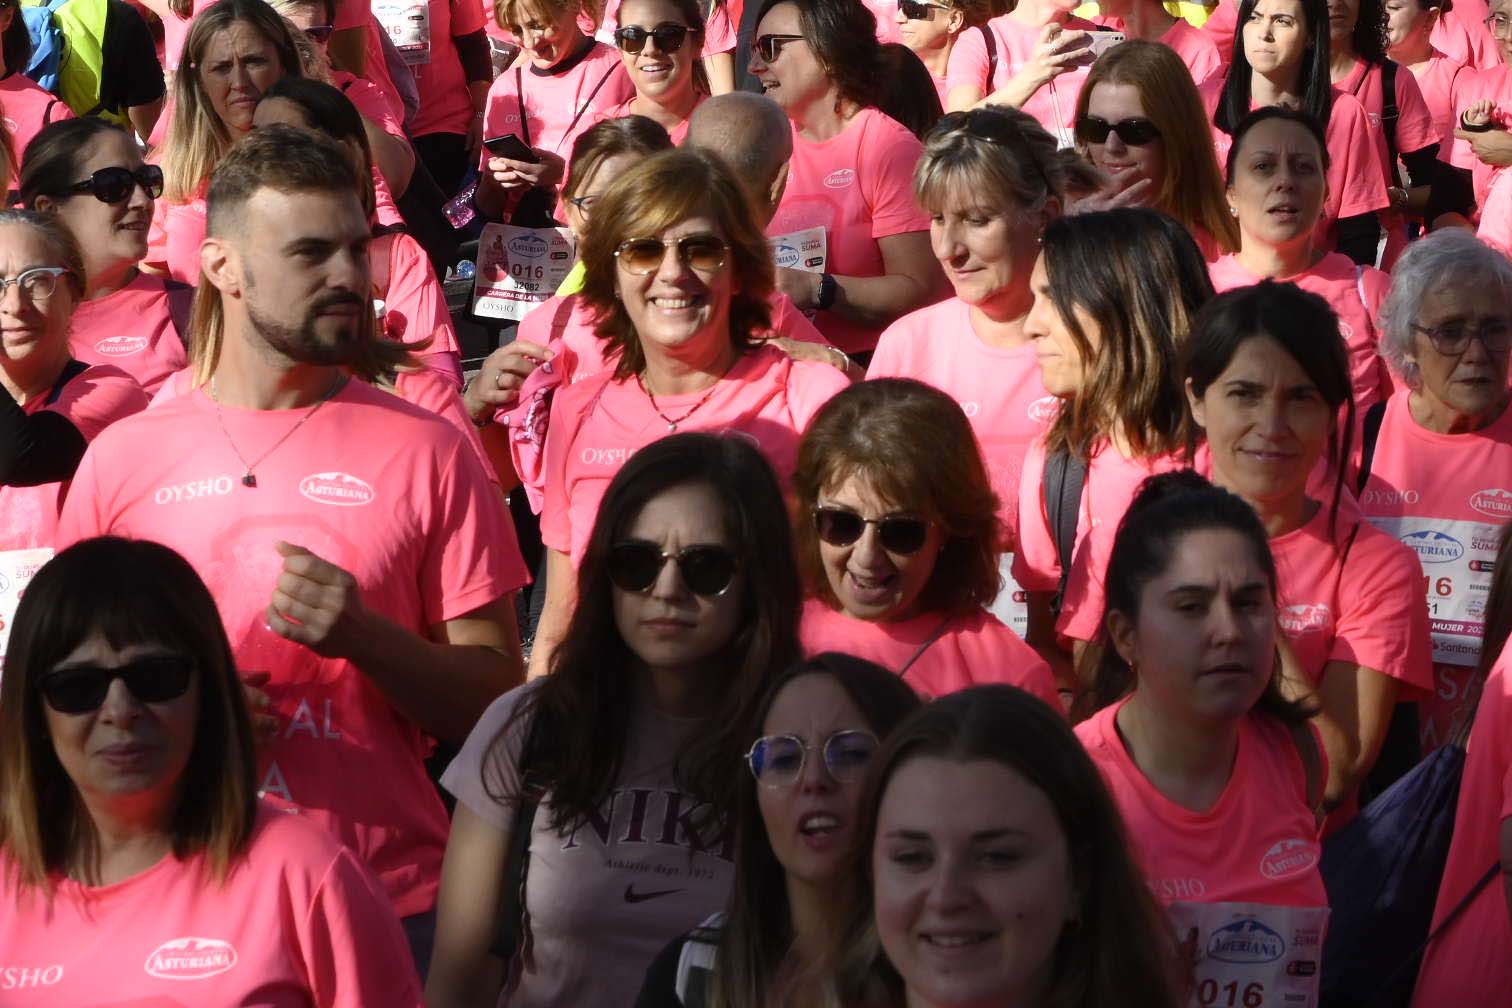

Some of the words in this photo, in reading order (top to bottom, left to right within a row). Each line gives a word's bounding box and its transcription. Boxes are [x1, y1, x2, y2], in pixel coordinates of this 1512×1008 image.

[383, 24, 403, 38] 16
[509, 242, 548, 255] ASTURIANA
[800, 243, 822, 253] SUMA
[511, 263, 545, 281] 016
[487, 290, 514, 300] CARRERA
[483, 303, 514, 314] OYSHO
[154, 476, 234, 506] OYSHO
[307, 480, 371, 501] ASTURIANA
[1422, 576, 1453, 597] 16
[1432, 621, 1465, 633] MUJER
[1466, 624, 1484, 635] 202
[151, 952, 230, 974] ASTURIANA
[0, 963, 64, 991] SHO
[1199, 977, 1265, 1008] 016
